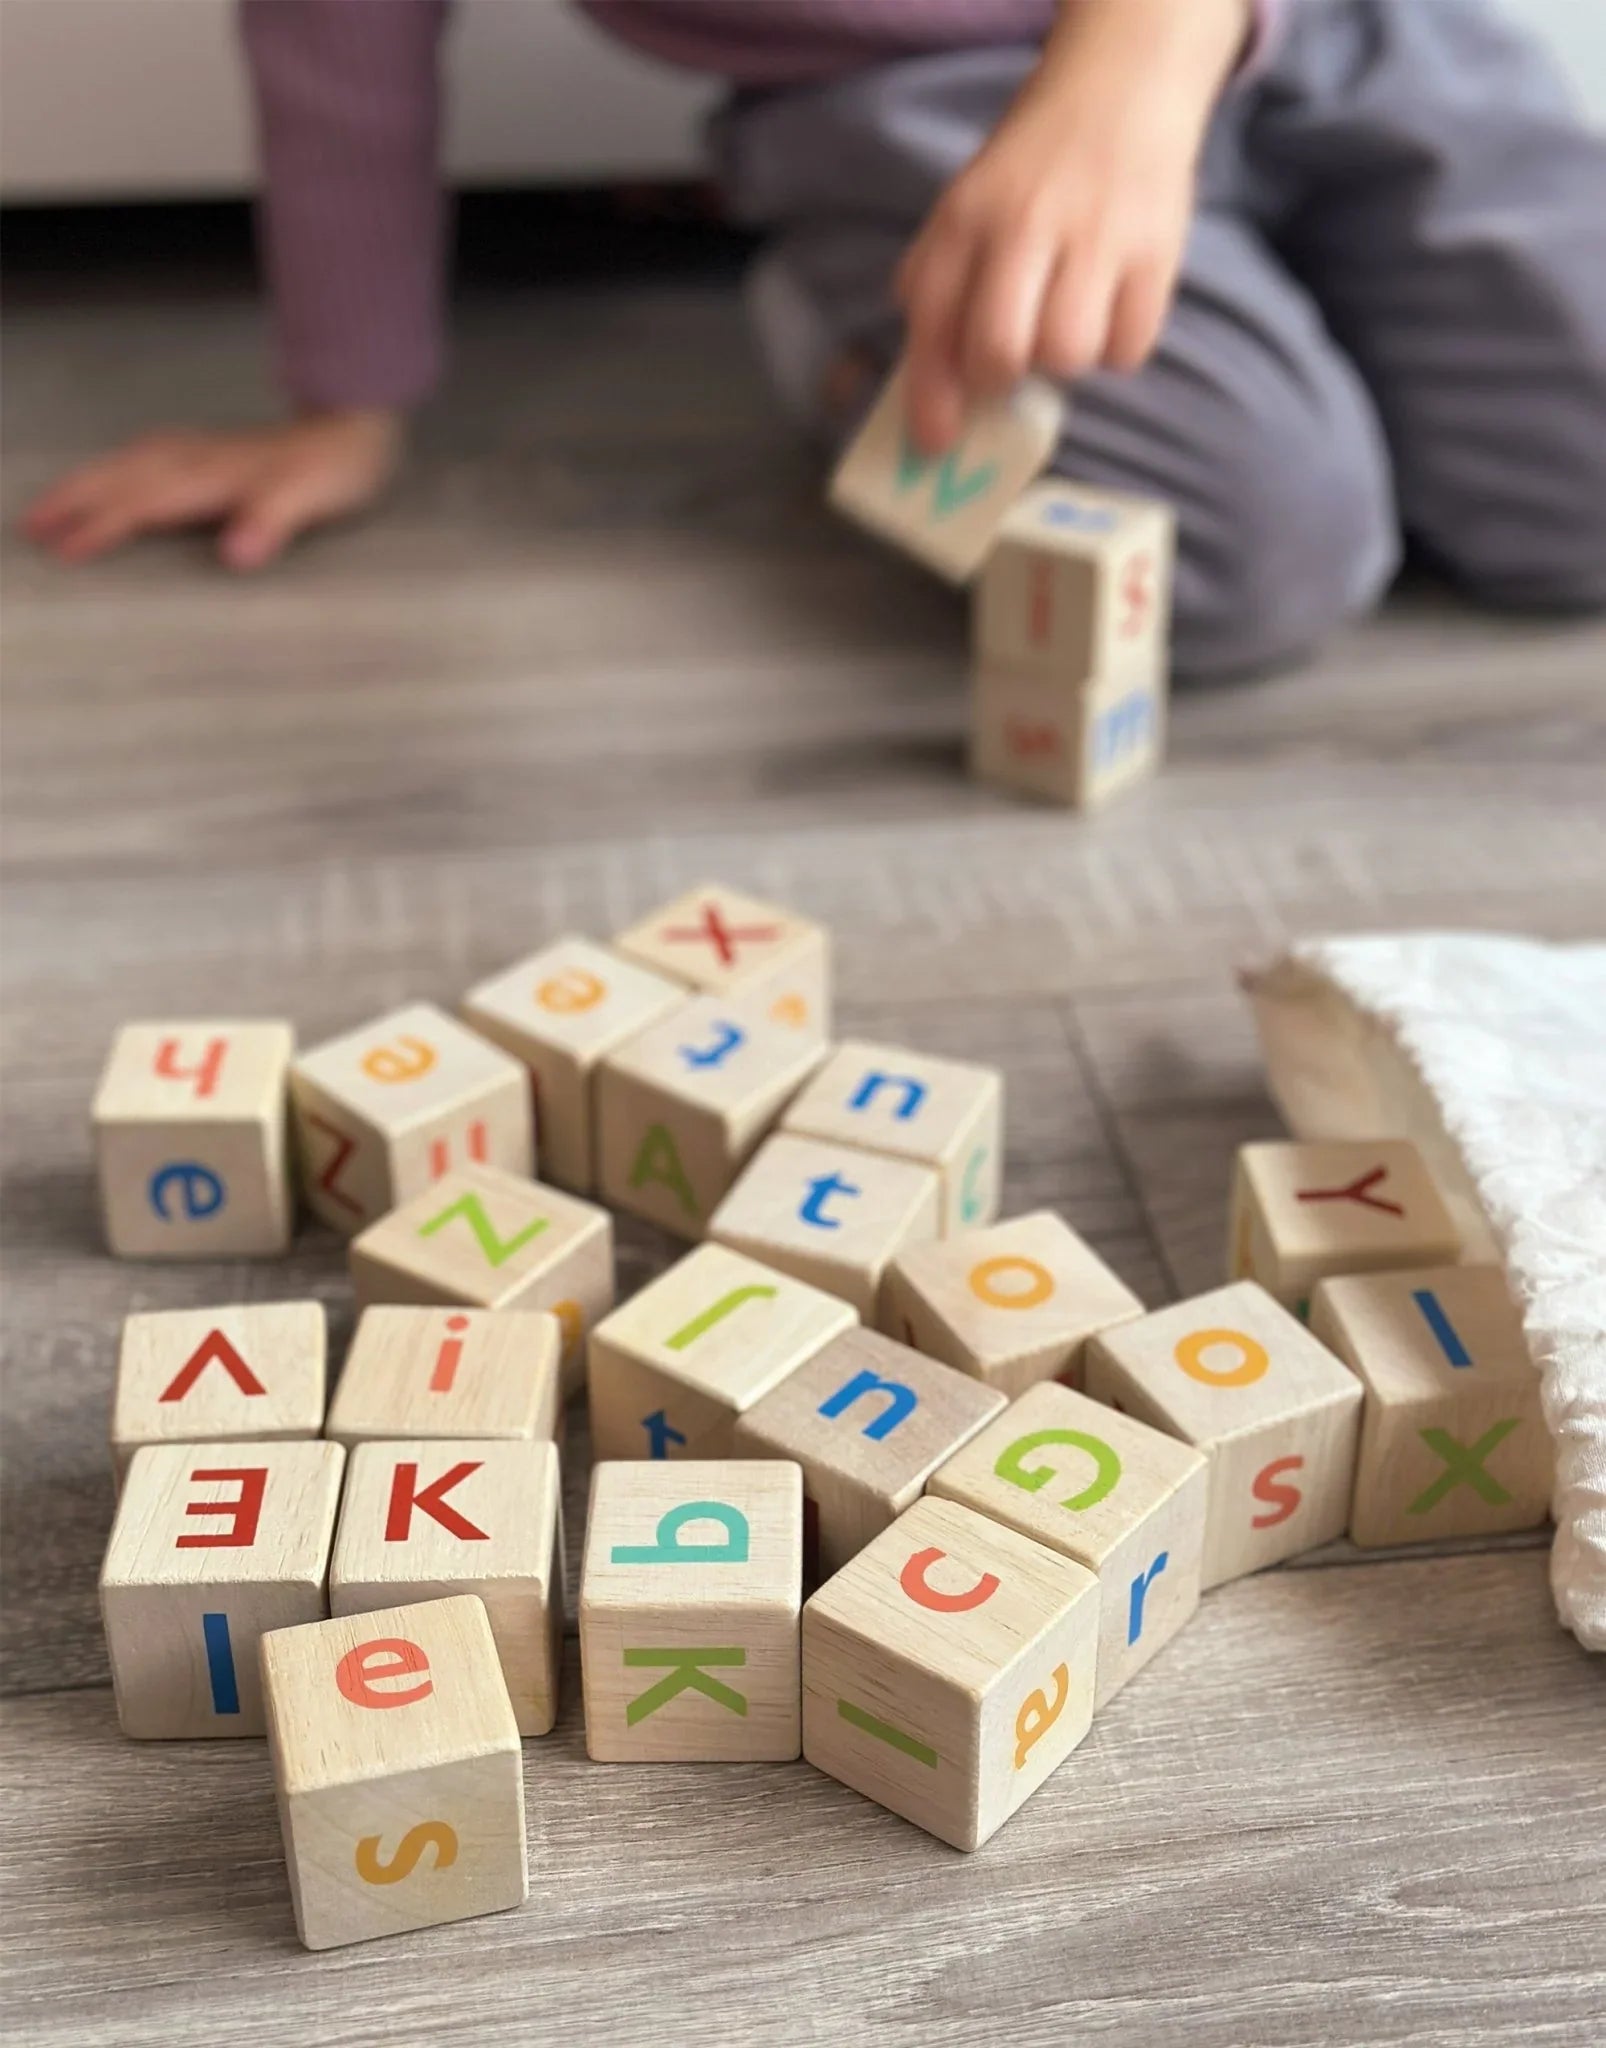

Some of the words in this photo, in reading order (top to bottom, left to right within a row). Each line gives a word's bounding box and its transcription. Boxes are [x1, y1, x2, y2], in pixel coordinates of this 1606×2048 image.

[148, 1162, 225, 1220] e
[628, 1122, 700, 1220] A
[799, 1174, 857, 1228] t
[1296, 1166, 1406, 1218] Y
[431, 1316, 468, 1393] i
[176, 1468, 267, 1548] E
[386, 1462, 488, 1541] K
[995, 1429, 1121, 1511] G
[1128, 1553, 1167, 1644] r
[336, 1639, 432, 1709] e
[623, 1647, 747, 1726] K
[1014, 1664, 1069, 1770] a
